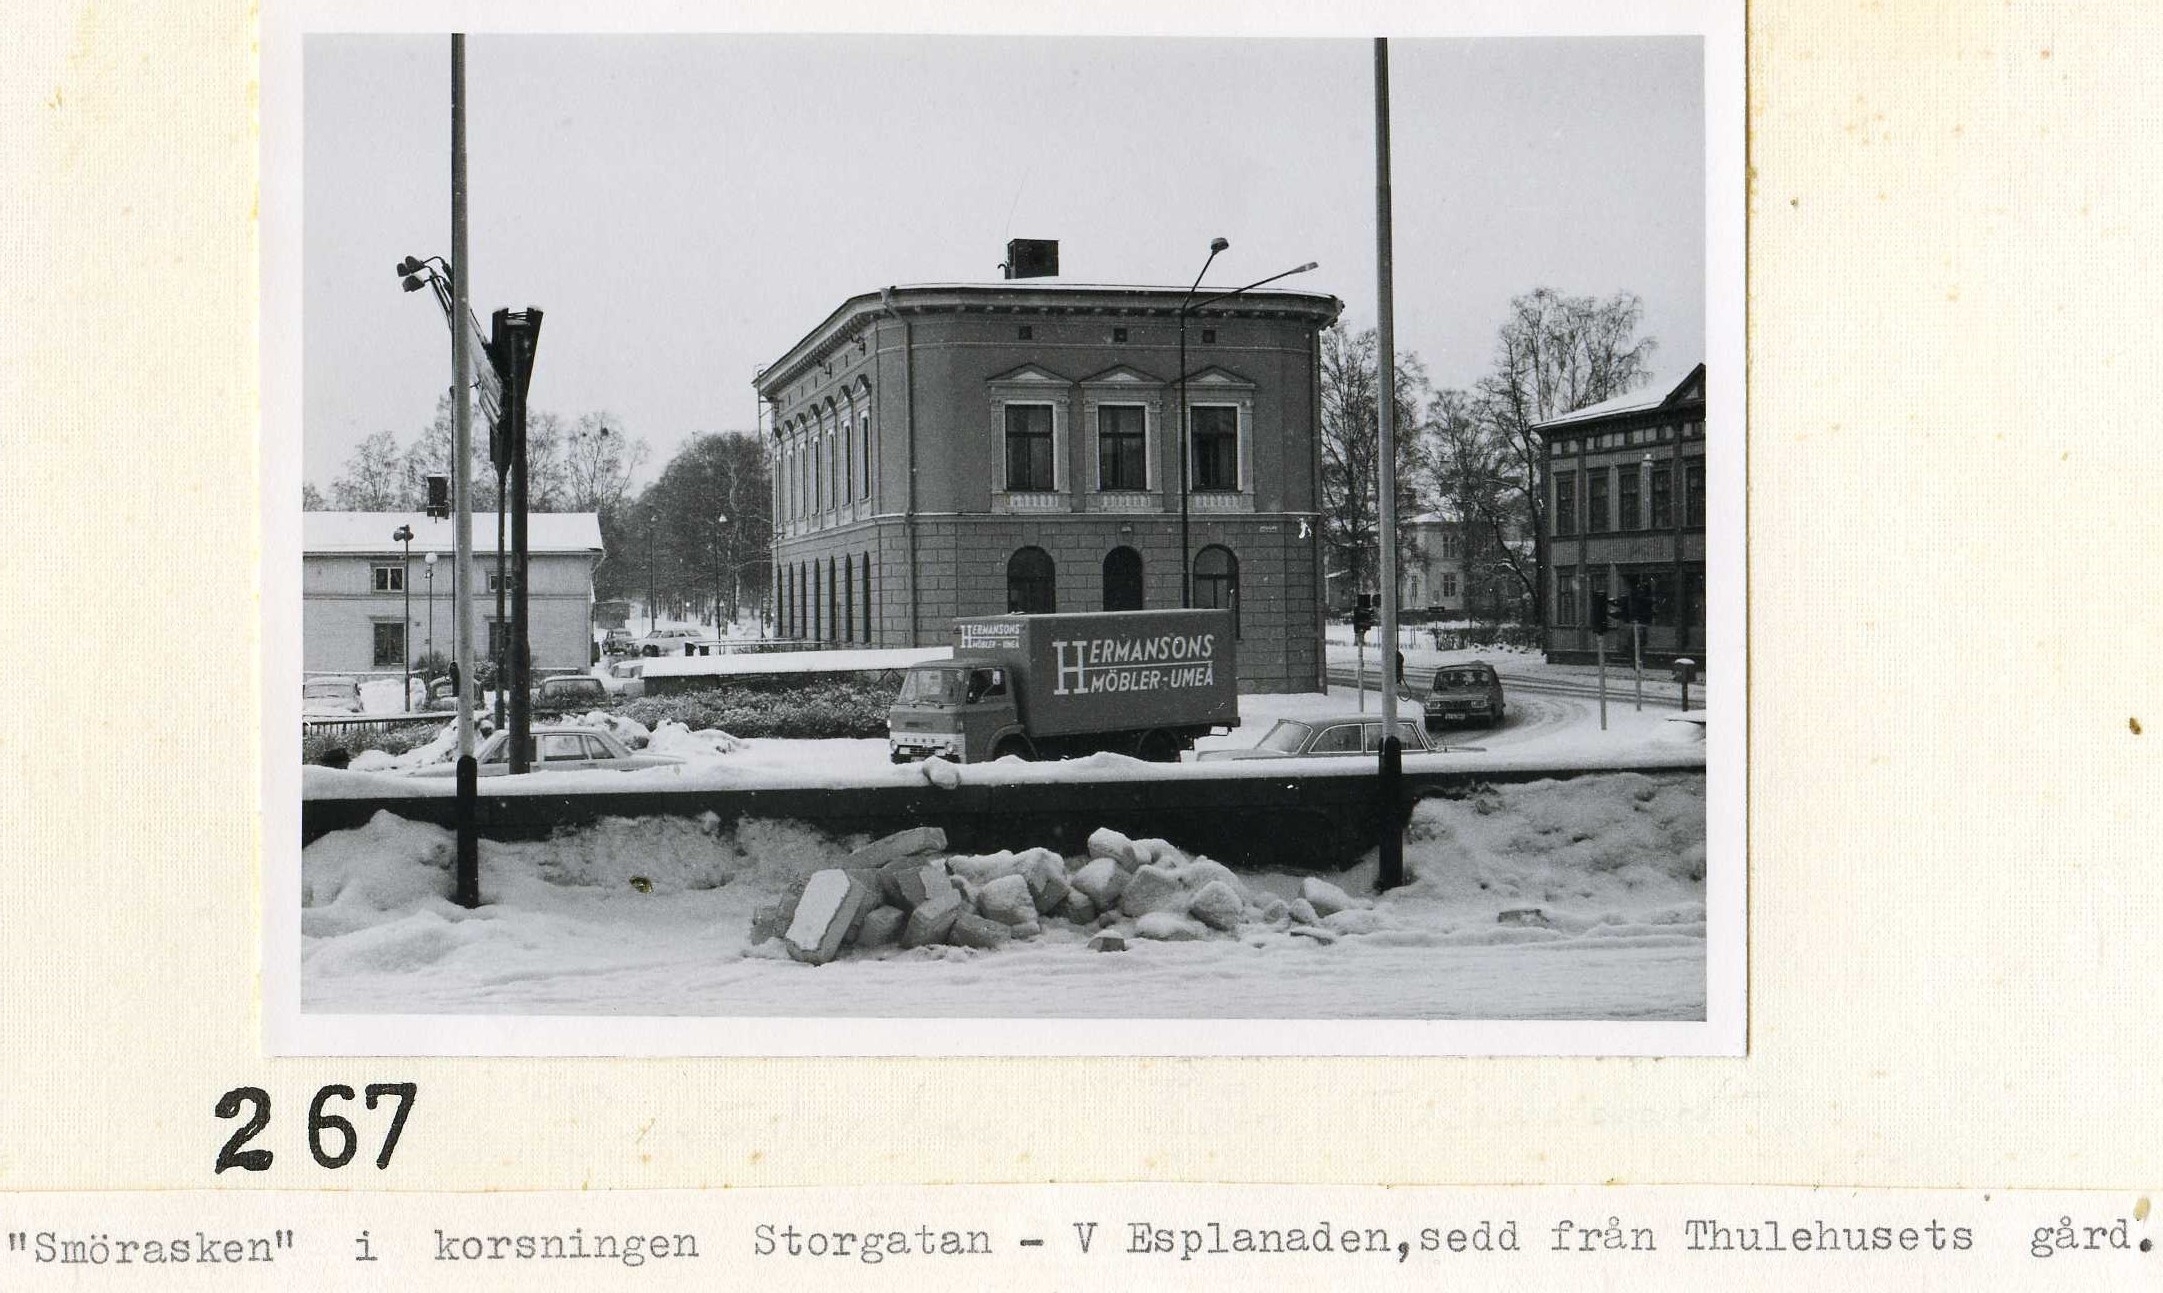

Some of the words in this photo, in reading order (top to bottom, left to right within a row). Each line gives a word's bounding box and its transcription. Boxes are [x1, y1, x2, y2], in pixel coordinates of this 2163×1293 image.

[960, 624, 1020, 648] HERMANSONS
[1051, 634, 1215, 695] HERMANSONS
[9, 1230, 293, 1264] "Smörasken"
[355, 1230, 378, 1262] i
[434, 1229, 699, 1266] korsningen
[754, 1224, 993, 1263] Storgatan
[1073, 1222, 1098, 1253] V
[1551, 1219, 1657, 1252] från
[1685, 1219, 1973, 1252] Thulehusets
[2030, 1215, 2153, 1258] gård.
